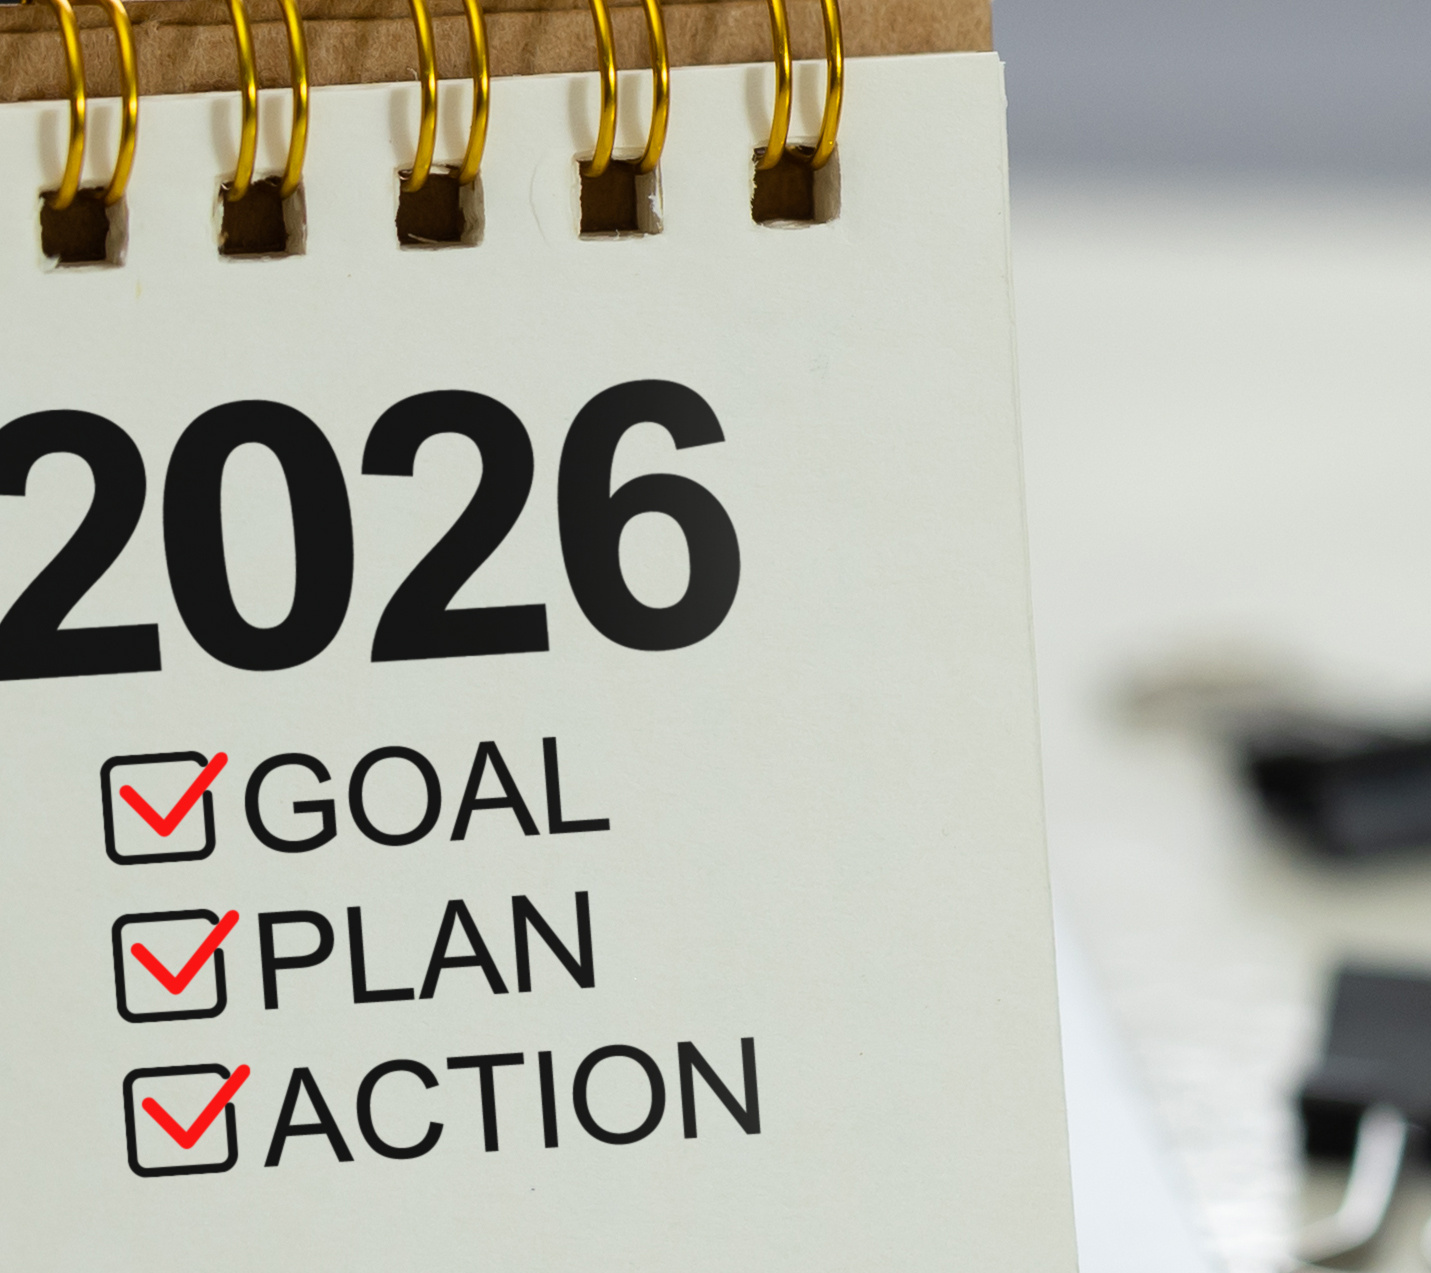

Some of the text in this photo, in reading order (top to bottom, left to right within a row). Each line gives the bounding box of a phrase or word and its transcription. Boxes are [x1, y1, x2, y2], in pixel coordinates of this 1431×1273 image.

[244, 736, 611, 854] GOAL
[257, 890, 596, 1010] PLAN
[264, 1037, 761, 1168] ACTION
